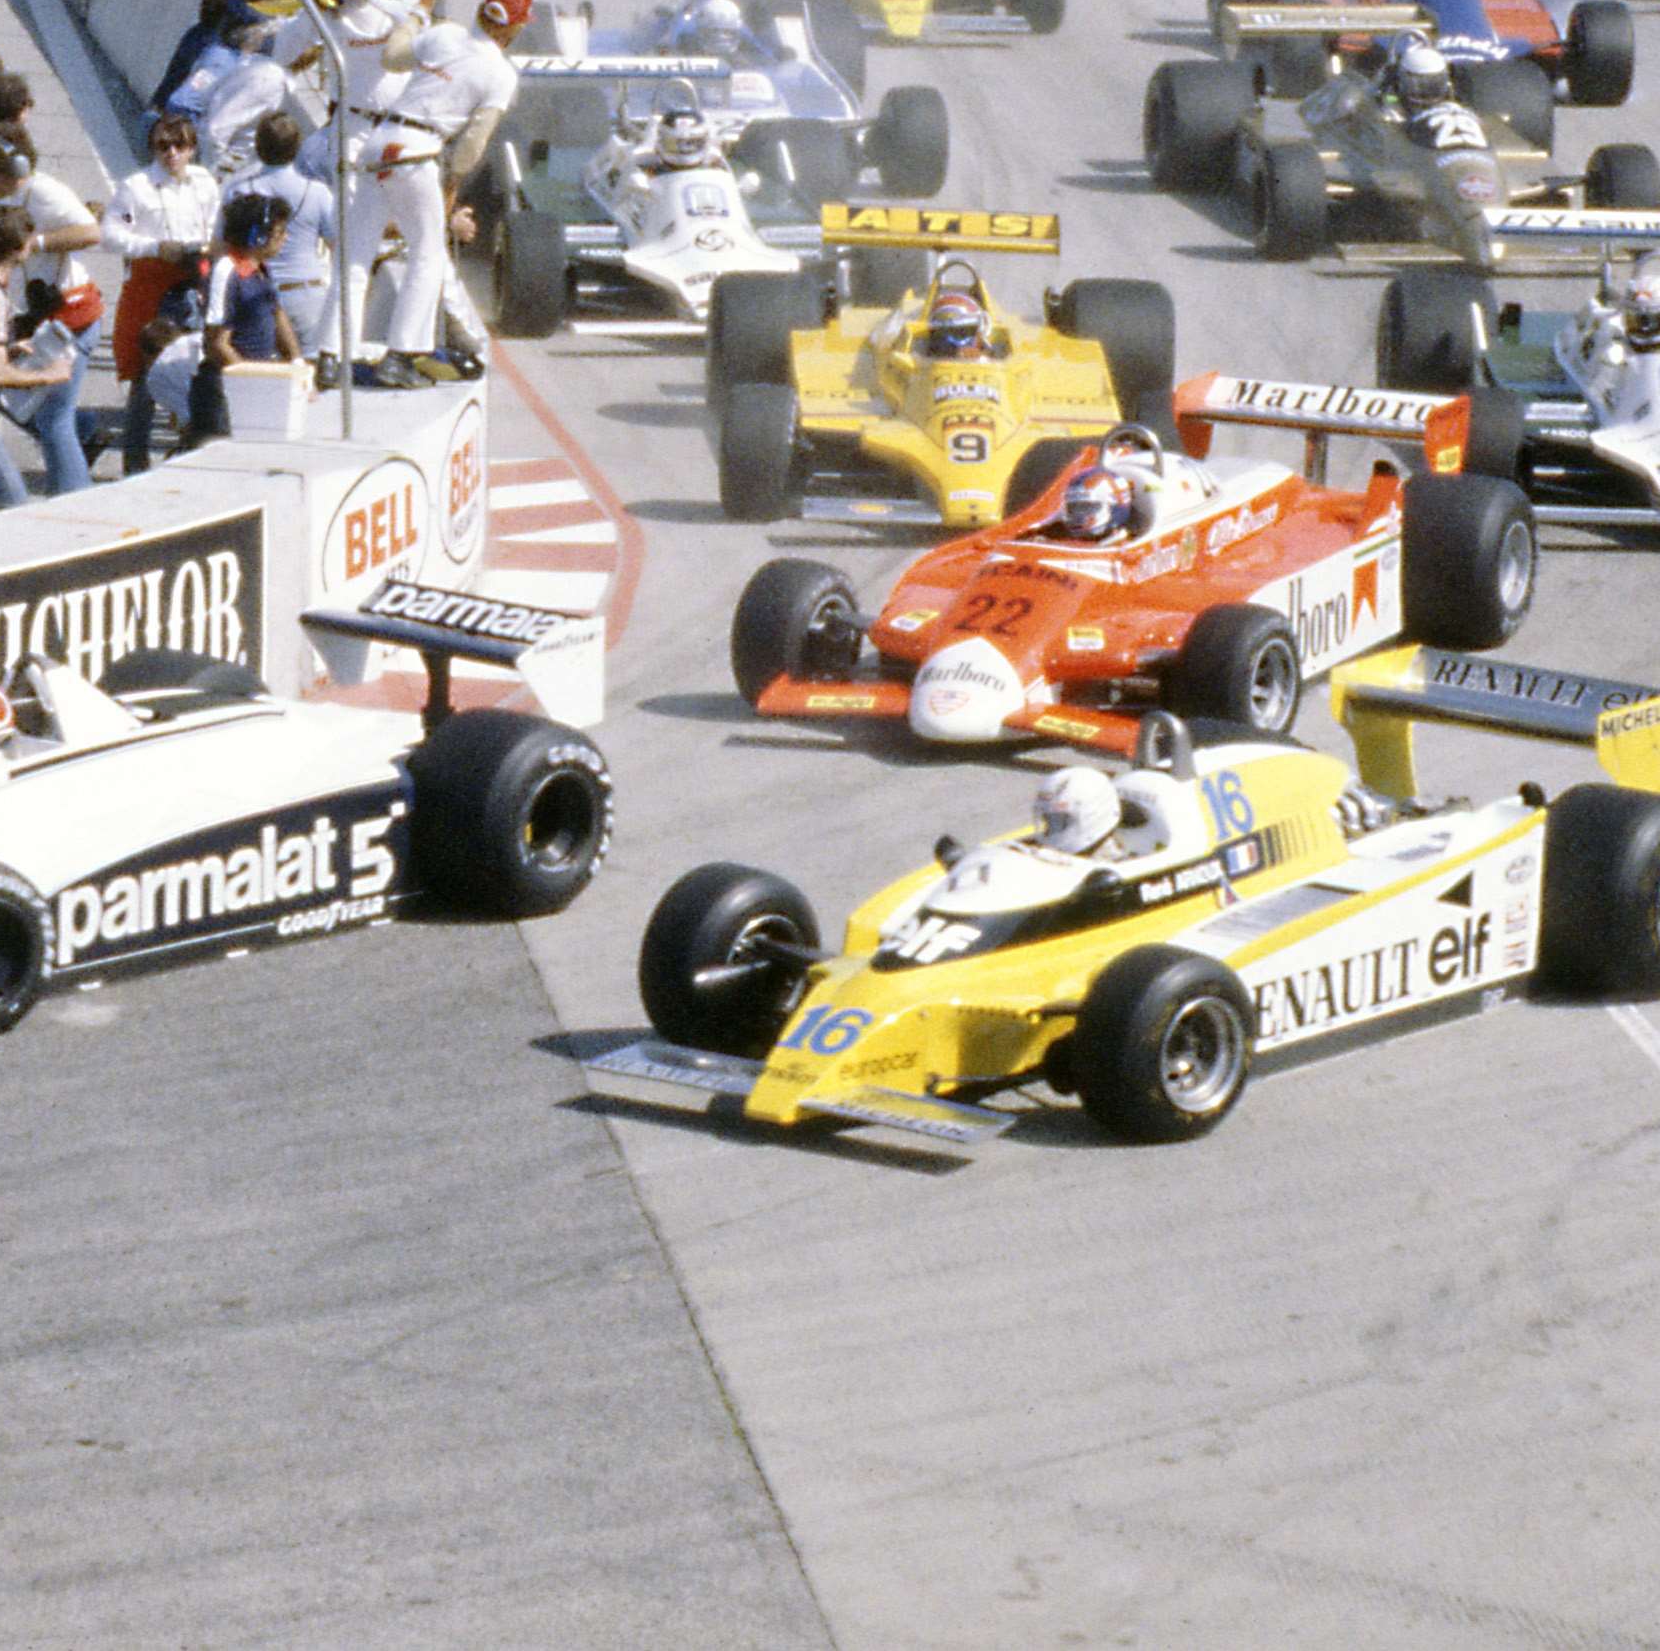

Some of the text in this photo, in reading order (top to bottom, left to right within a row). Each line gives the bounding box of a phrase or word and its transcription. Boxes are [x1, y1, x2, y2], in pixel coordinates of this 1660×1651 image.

[1228, 378, 1436, 425] Marlboro
[949, 428, 989, 465] 9
[344, 482, 419, 583] BELL
[371, 584, 566, 640] parmala
[952, 593, 1035, 638] 22
[1288, 574, 1349, 665] lboro
[1201, 770, 1255, 842] 16
[56, 816, 338, 966] parmalat
[349, 801, 406, 897] 5
[276, 895, 388, 936] GOODYEAR
[1251, 936, 1420, 1041] ENAULT
[1428, 912, 1493, 988] elf
[777, 1003, 873, 1056] 16
